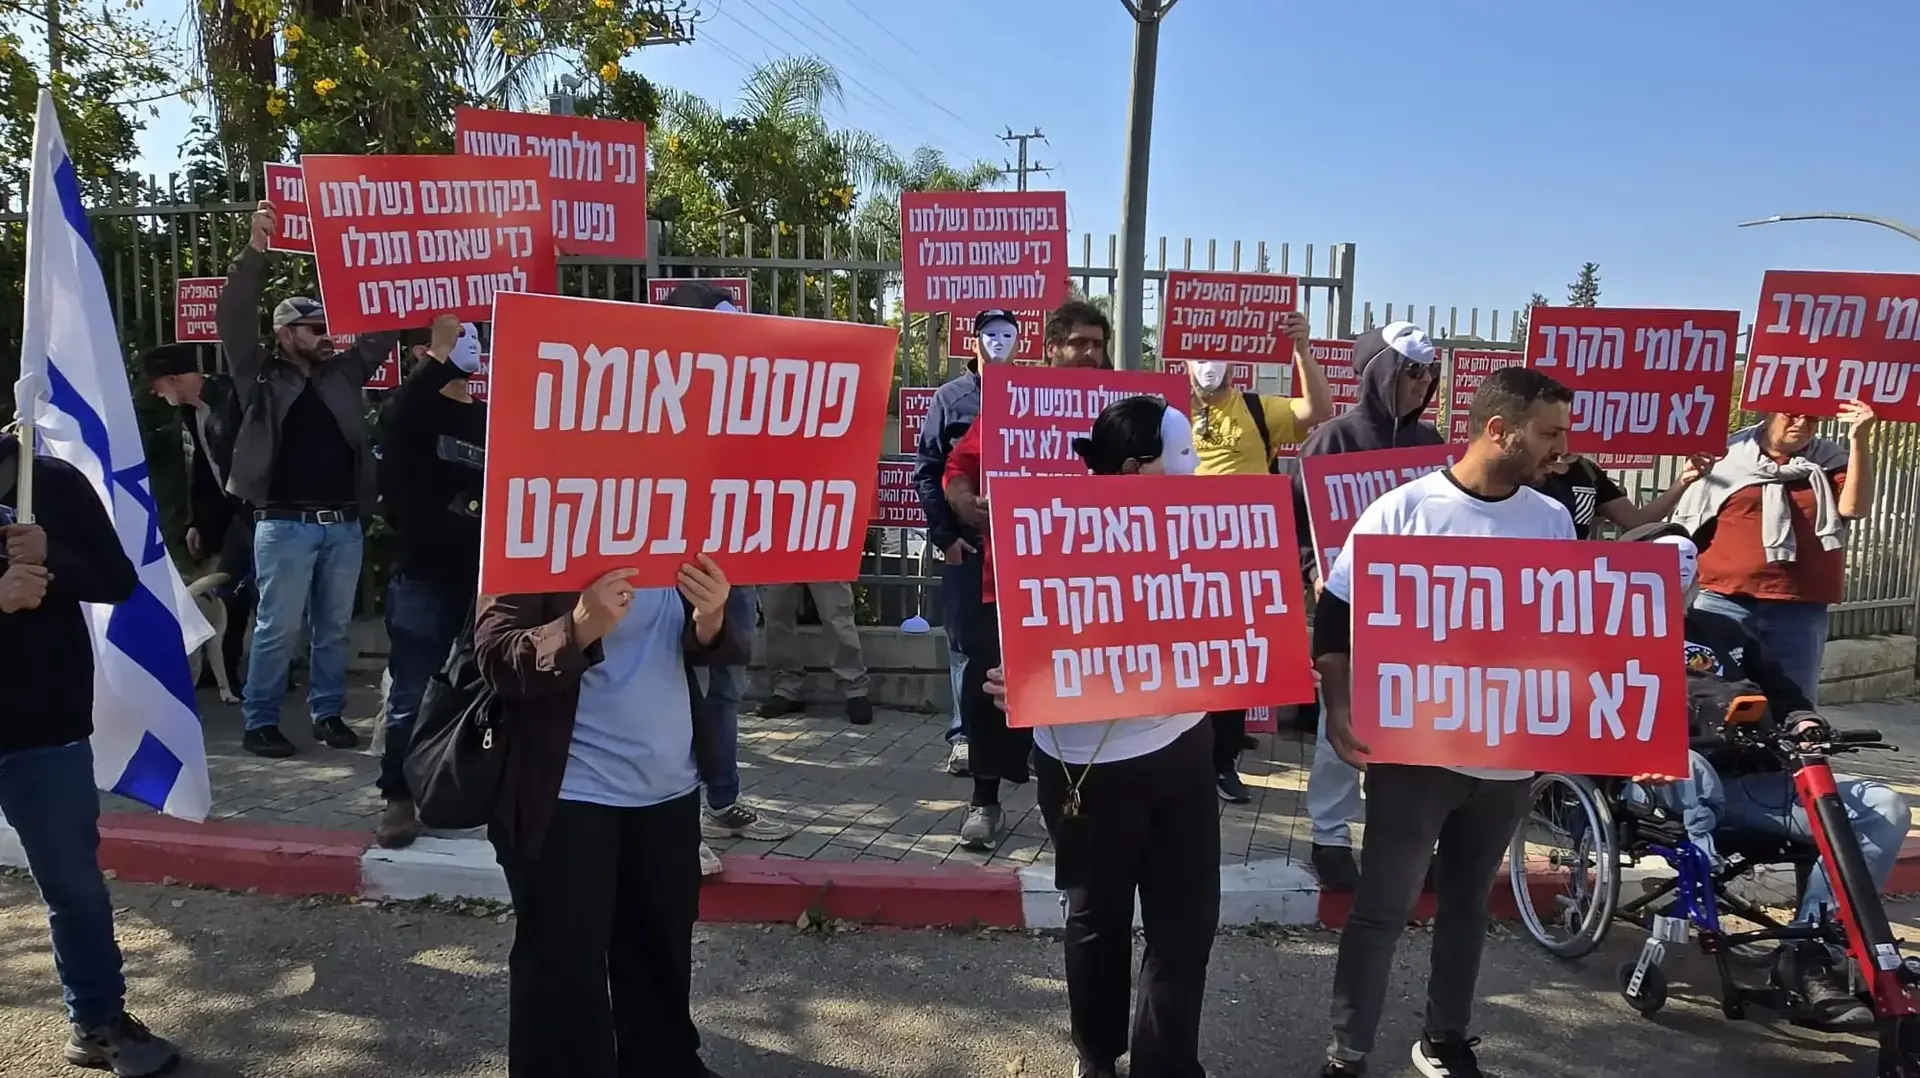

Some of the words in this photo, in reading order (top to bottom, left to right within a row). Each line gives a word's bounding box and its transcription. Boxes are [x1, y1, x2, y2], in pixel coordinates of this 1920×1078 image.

[608, 143, 636, 184] נכי
[275, 175, 303, 203] ומי
[320, 175, 414, 217] נשלחנו
[419, 180, 541, 218] בפקודתכם
[574, 201, 614, 242] נפש
[909, 203, 968, 232] נשלחנו
[973, 207, 1059, 235] בפקודתכם
[342, 226, 411, 267] תוכלו
[417, 228, 491, 262] שאתם
[496, 226, 532, 258] כדי
[920, 238, 963, 266] תוכלו
[969, 242, 1020, 265] שאתם
[1025, 241, 1050, 264] כדי
[181, 284, 217, 299] האפליה
[359, 277, 461, 318] והופקרנו
[927, 275, 995, 304] והופקרנו
[1000, 270, 1045, 298] לחיות
[1175, 279, 1236, 302] האפליה
[1240, 284, 1290, 305] תופסק
[181, 303, 207, 320] הקרב
[1173, 307, 1215, 328] הקרב
[1220, 307, 1264, 328] הלומי
[1766, 293, 1866, 343] הקרב
[1181, 333, 1227, 351] פיזיים
[1231, 333, 1276, 354] לנכים
[1536, 326, 1624, 376] הקרב
[1635, 320, 1726, 371] הלומי
[534, 342, 859, 437] פוסטראומה
[1748, 355, 1828, 402] צדק
[1835, 359, 1920, 404] שים
[1006, 380, 1031, 419] על
[1034, 386, 1084, 420] בנפשו
[1569, 389, 1659, 442] שקופ
[1667, 386, 1714, 435] לא
[999, 428, 1036, 464] צריך
[1039, 425, 1063, 460] לא
[506, 478, 687, 573] בשקט
[702, 479, 856, 553] הורגת
[1014, 498, 1156, 555] האפליה
[1165, 505, 1278, 560] תופסק
[1020, 576, 1123, 634] הקרב
[1133, 563, 1232, 621] הלומי
[1240, 570, 1287, 624] בין
[1368, 563, 1504, 641] הקרב
[1521, 557, 1667, 637] הלומי
[1052, 644, 1163, 699] פיזיים
[1172, 628, 1268, 689] לנכים
[1378, 663, 1570, 747] שקופים
[1588, 659, 1659, 741] לא
